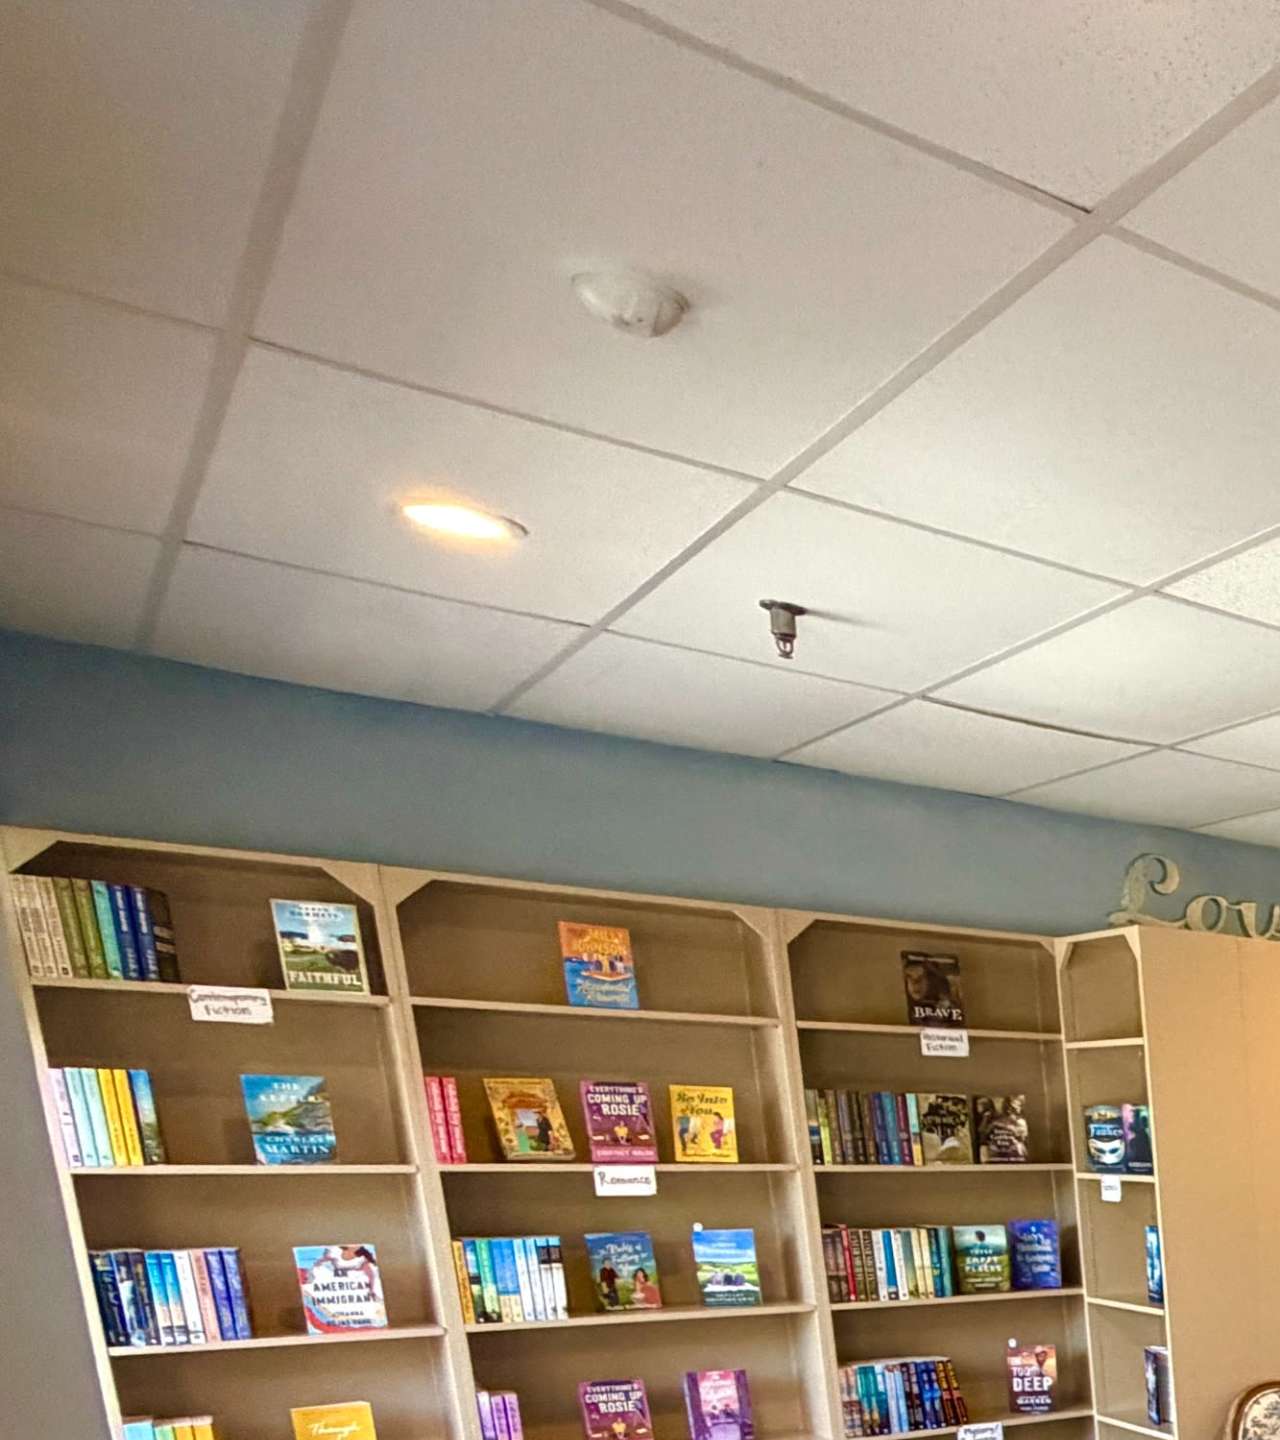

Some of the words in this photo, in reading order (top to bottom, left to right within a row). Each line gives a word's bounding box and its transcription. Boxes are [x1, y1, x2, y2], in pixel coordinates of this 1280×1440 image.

[288, 971, 362, 985] FAITHFUL
[914, 1006, 962, 1021] BRAVE
[588, 1094, 630, 1104] COMING
[633, 1094, 648, 1104] UP
[601, 1104, 641, 1116] ROSIE
[264, 1144, 329, 1154] MARTIN
[597, 1171, 652, 1187] Romance
[313, 1281, 372, 1292] AMERICAN
[312, 1293, 377, 1306] IMMIGRANT
[1012, 1376, 1053, 1392] DEEP
[585, 1392, 625, 1403] COMING
[628, 1391, 644, 1400] UP
[598, 1401, 636, 1413] ROSIE
